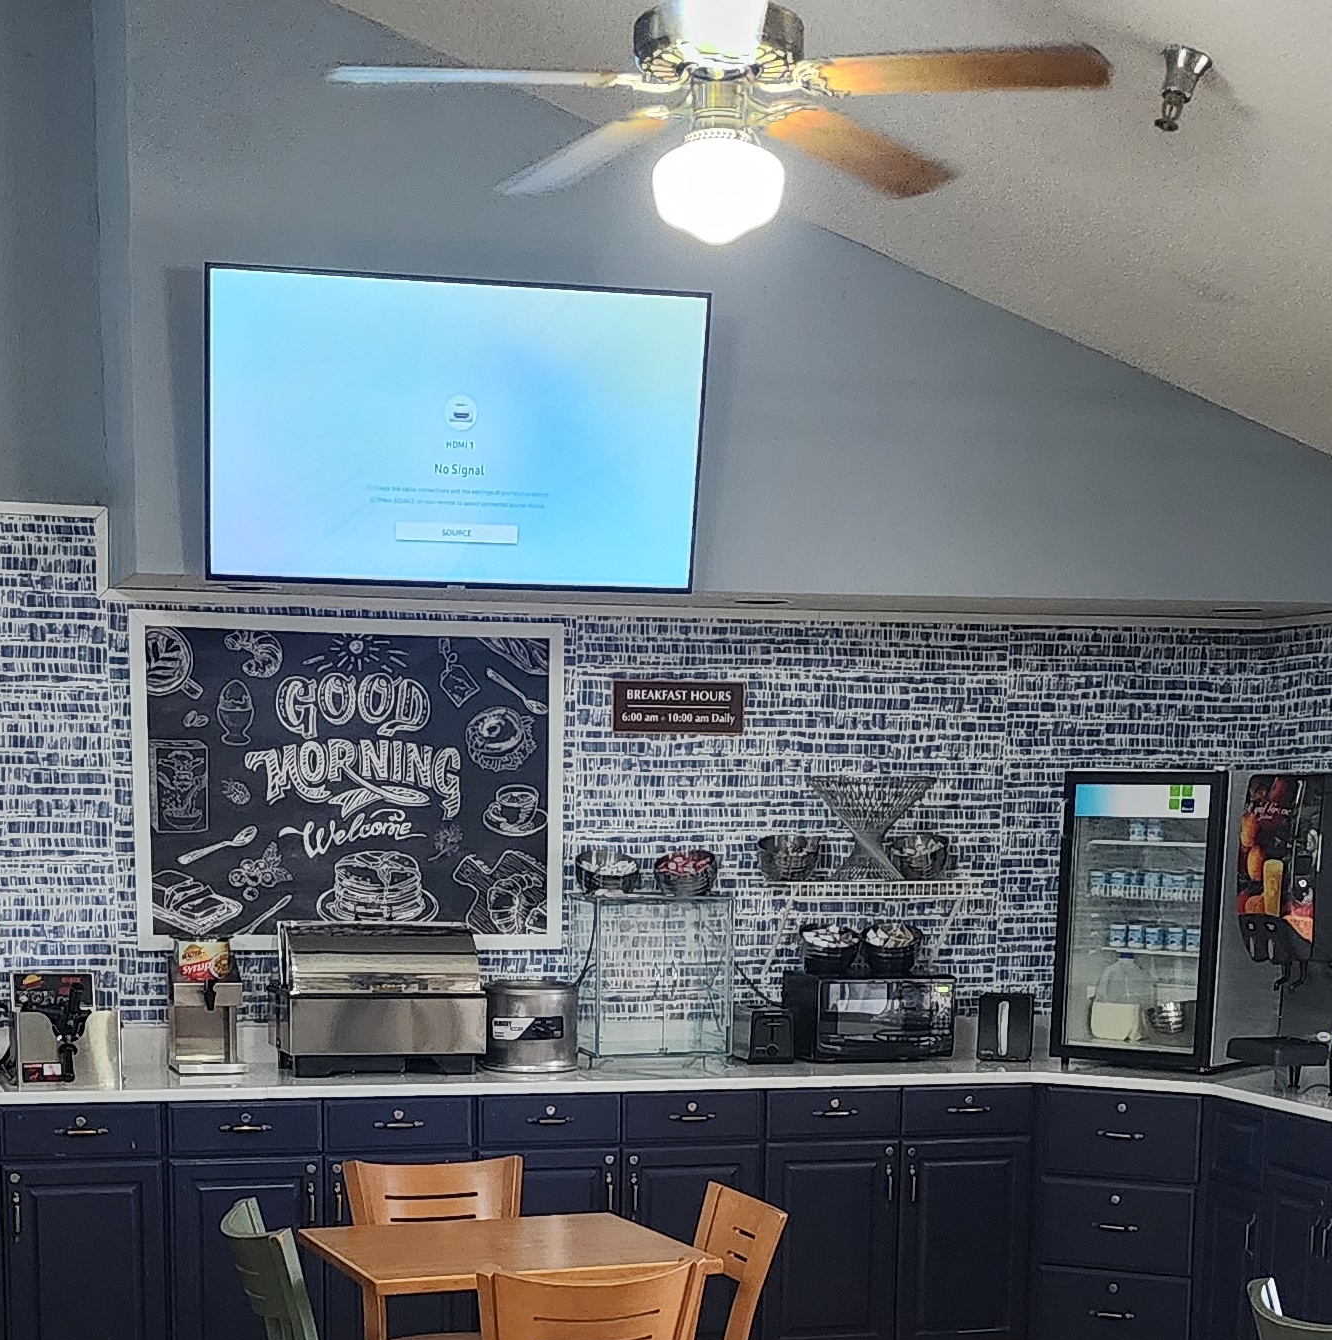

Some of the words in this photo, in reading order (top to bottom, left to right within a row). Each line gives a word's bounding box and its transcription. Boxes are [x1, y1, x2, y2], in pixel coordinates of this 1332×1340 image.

[446, 440, 468, 449] HDMI
[469, 441, 474, 450] 1
[434, 463, 449, 474] No
[451, 463, 485, 478] Signal
[442, 528, 472, 537] SOURCE
[626, 689, 688, 701] BREAKFAST
[690, 690, 732, 702] HOURS
[276, 671, 430, 739] GOOD
[621, 712, 643, 722] 6:00
[644, 714, 659, 722] am
[668, 712, 693, 723] 10:00
[694, 715, 710, 723] am
[711, 713, 736, 726] Daily
[245, 738, 462, 820] MORNING
[278, 808, 427, 858] Welcome
